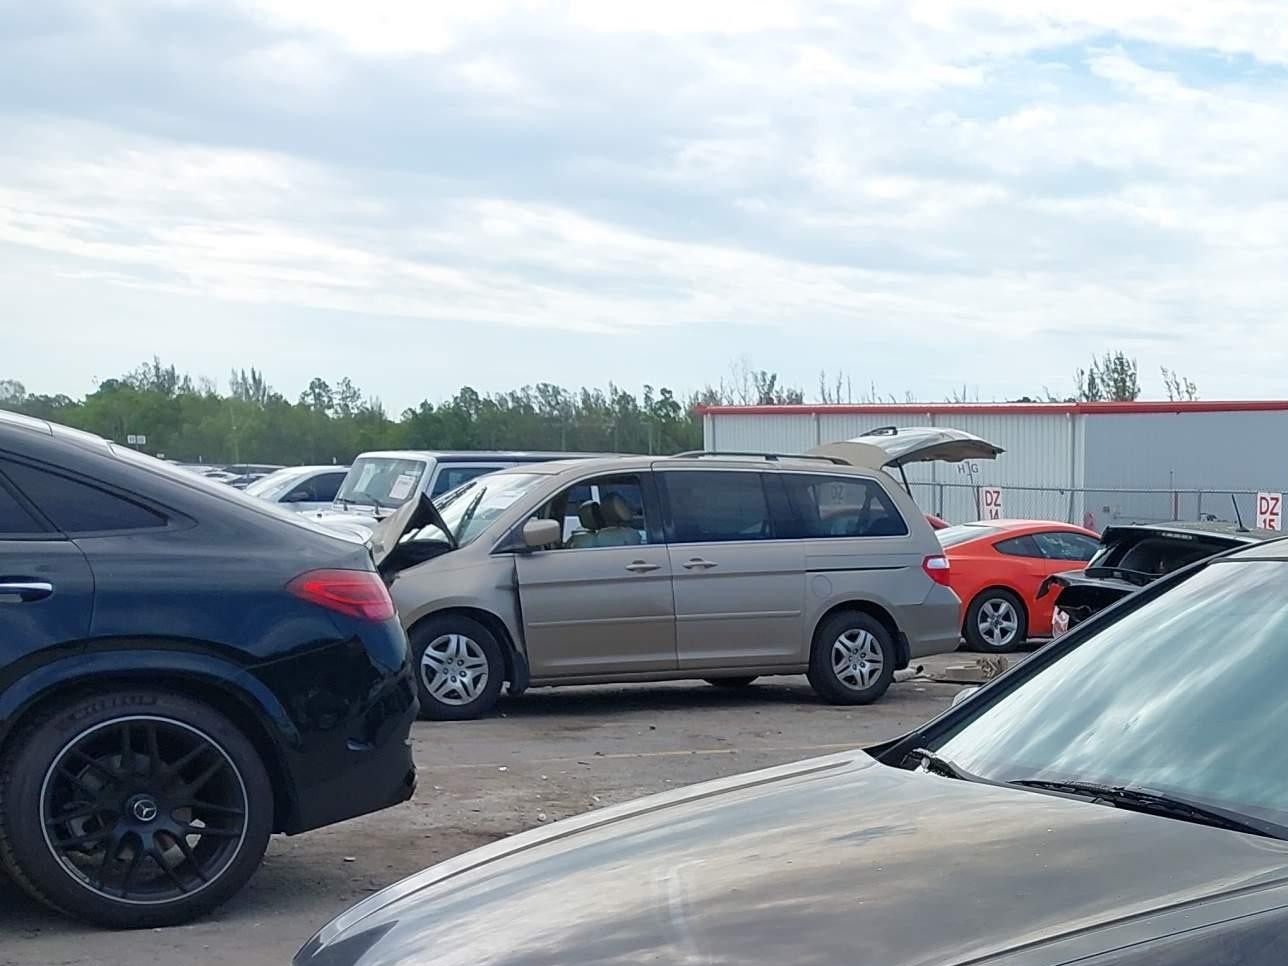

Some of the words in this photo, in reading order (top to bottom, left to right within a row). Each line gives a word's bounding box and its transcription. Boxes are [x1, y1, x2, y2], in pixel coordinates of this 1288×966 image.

[985, 490, 1002, 507] DZ
[1260, 496, 1280, 516] DZ
[1262, 518, 1276, 530] 15
